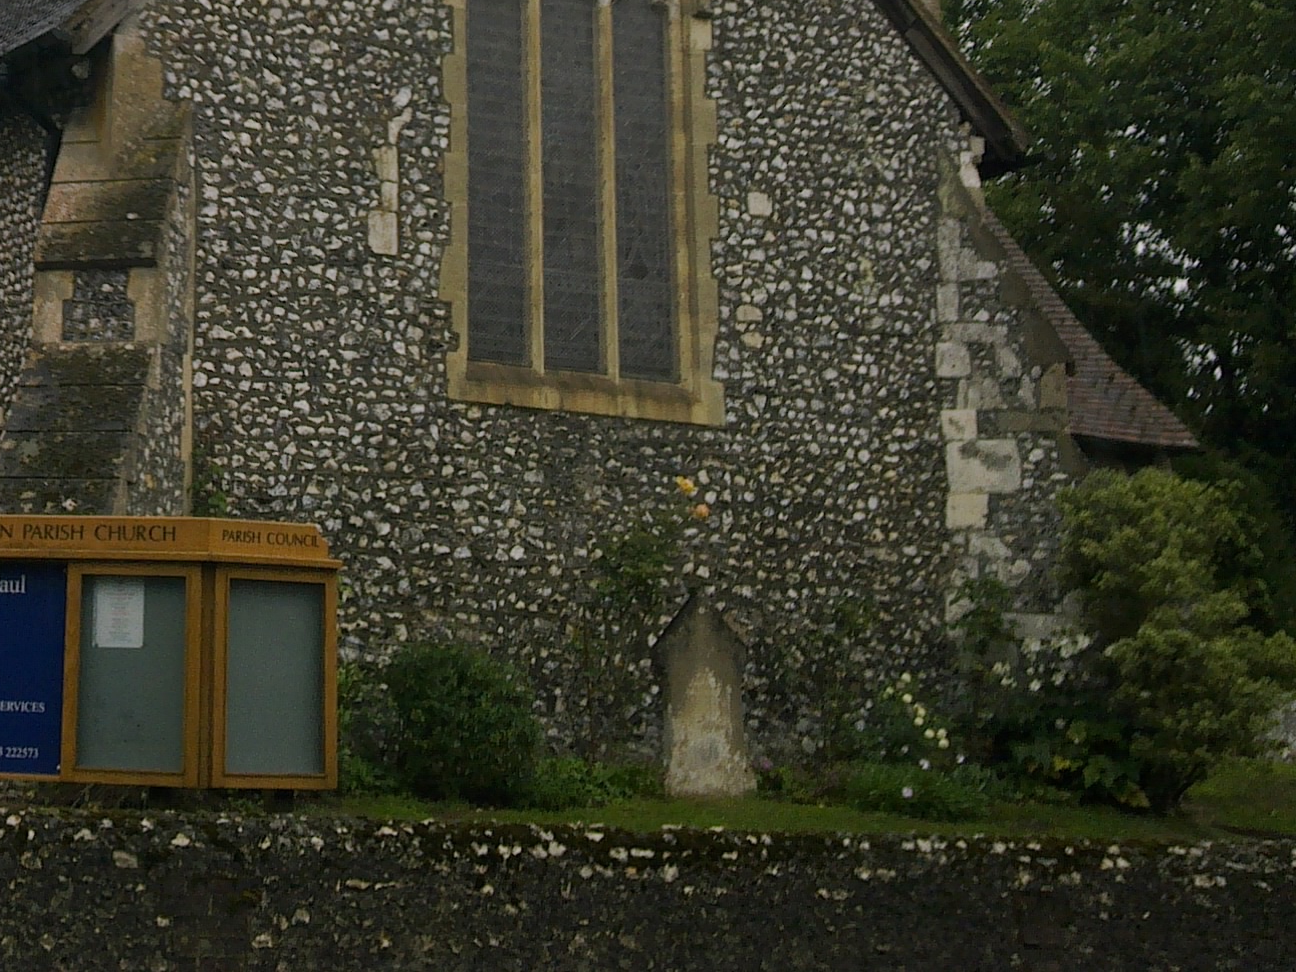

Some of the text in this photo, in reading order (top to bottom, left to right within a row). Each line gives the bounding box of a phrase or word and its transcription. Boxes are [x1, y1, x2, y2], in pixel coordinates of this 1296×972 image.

[22, 523, 85, 541] PARISH
[94, 525, 177, 542] CHURCH
[222, 529, 319, 547] PARISH COUNCIL
